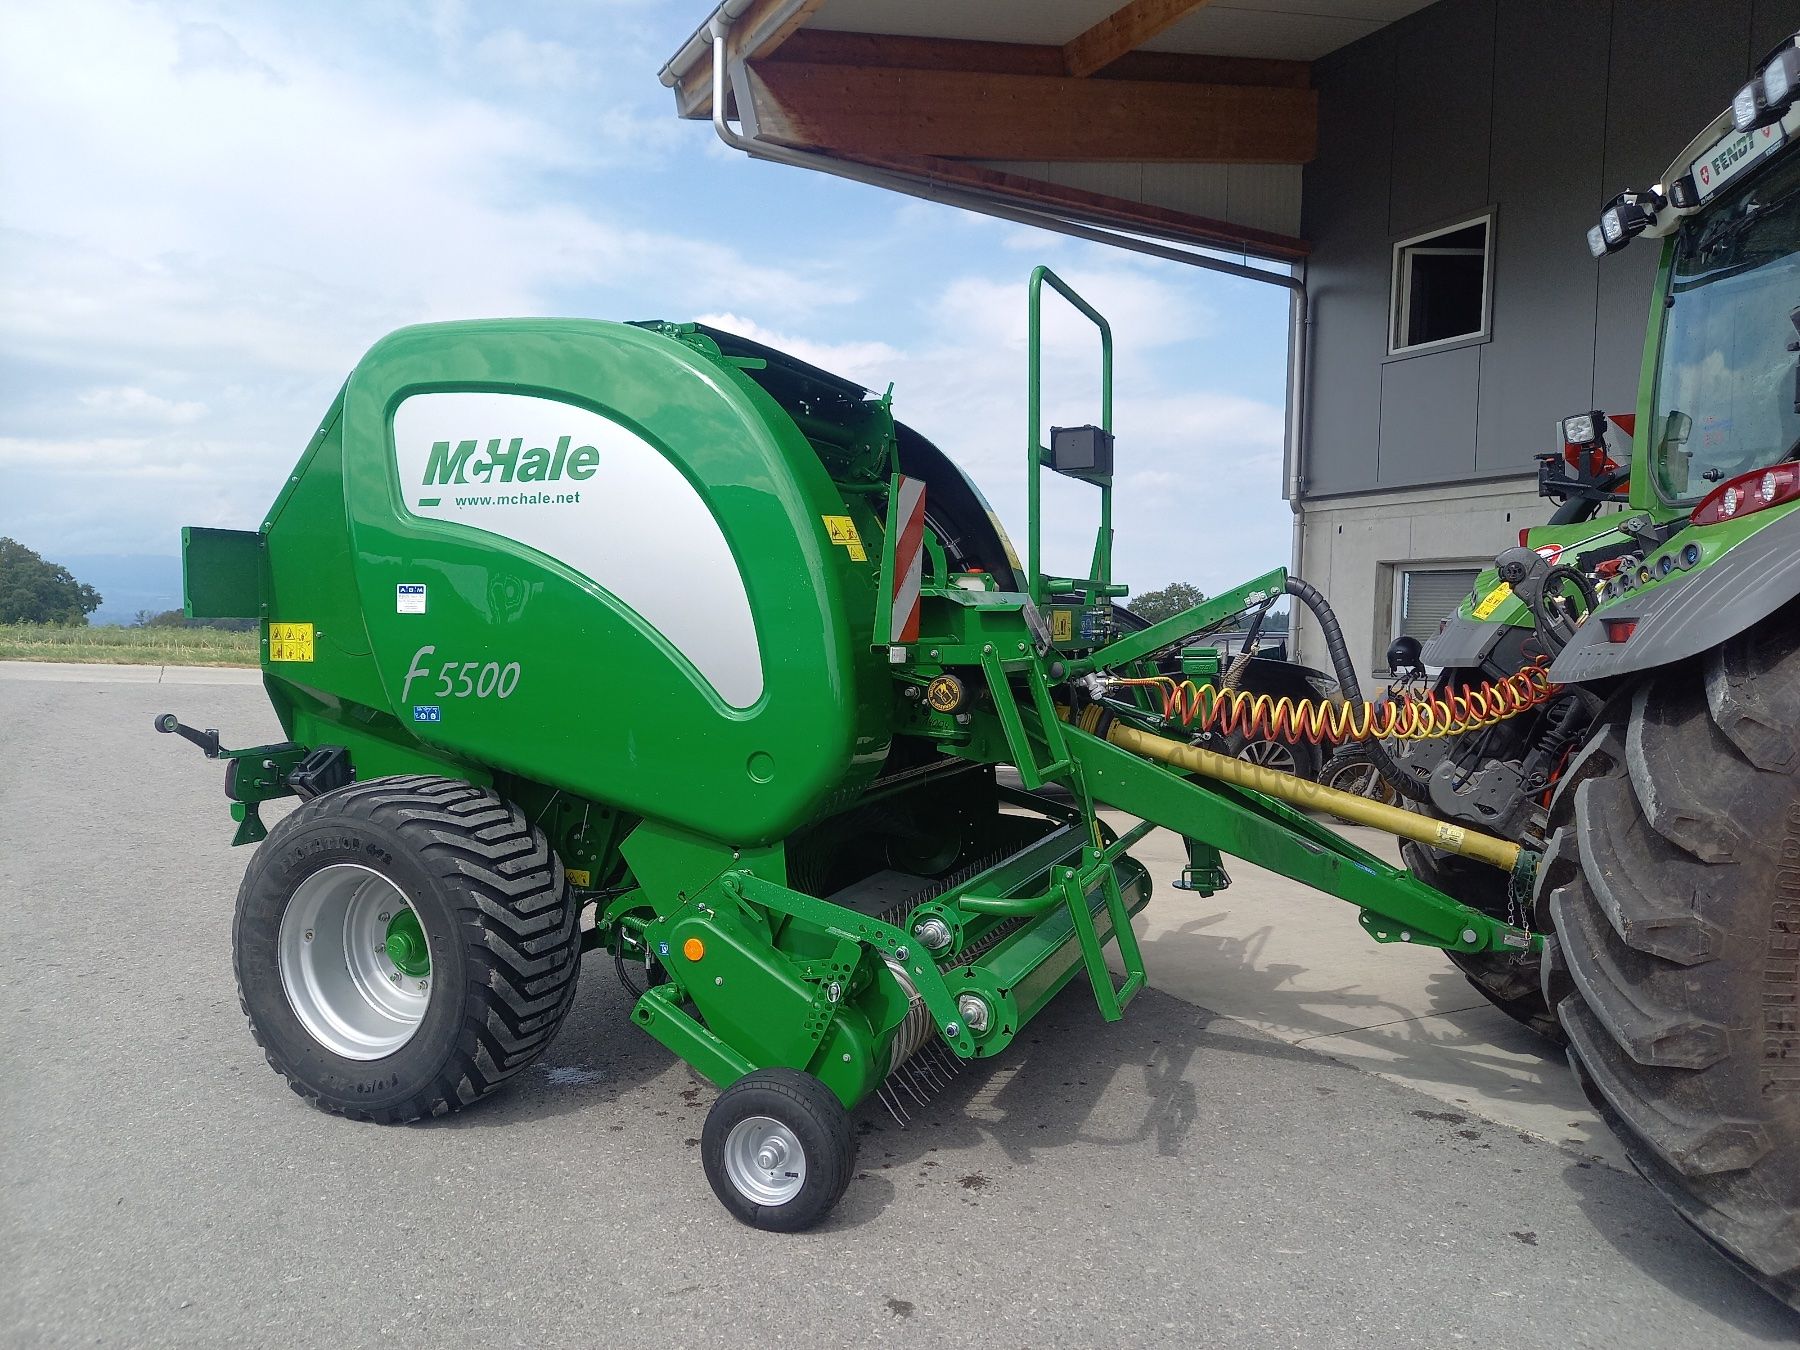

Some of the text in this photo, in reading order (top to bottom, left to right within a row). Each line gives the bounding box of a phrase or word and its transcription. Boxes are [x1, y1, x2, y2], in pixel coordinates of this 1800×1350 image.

[1711, 132, 1755, 176] FENDT
[422, 436, 600, 485] McHale
[455, 491, 580, 506] www.mchale.net
